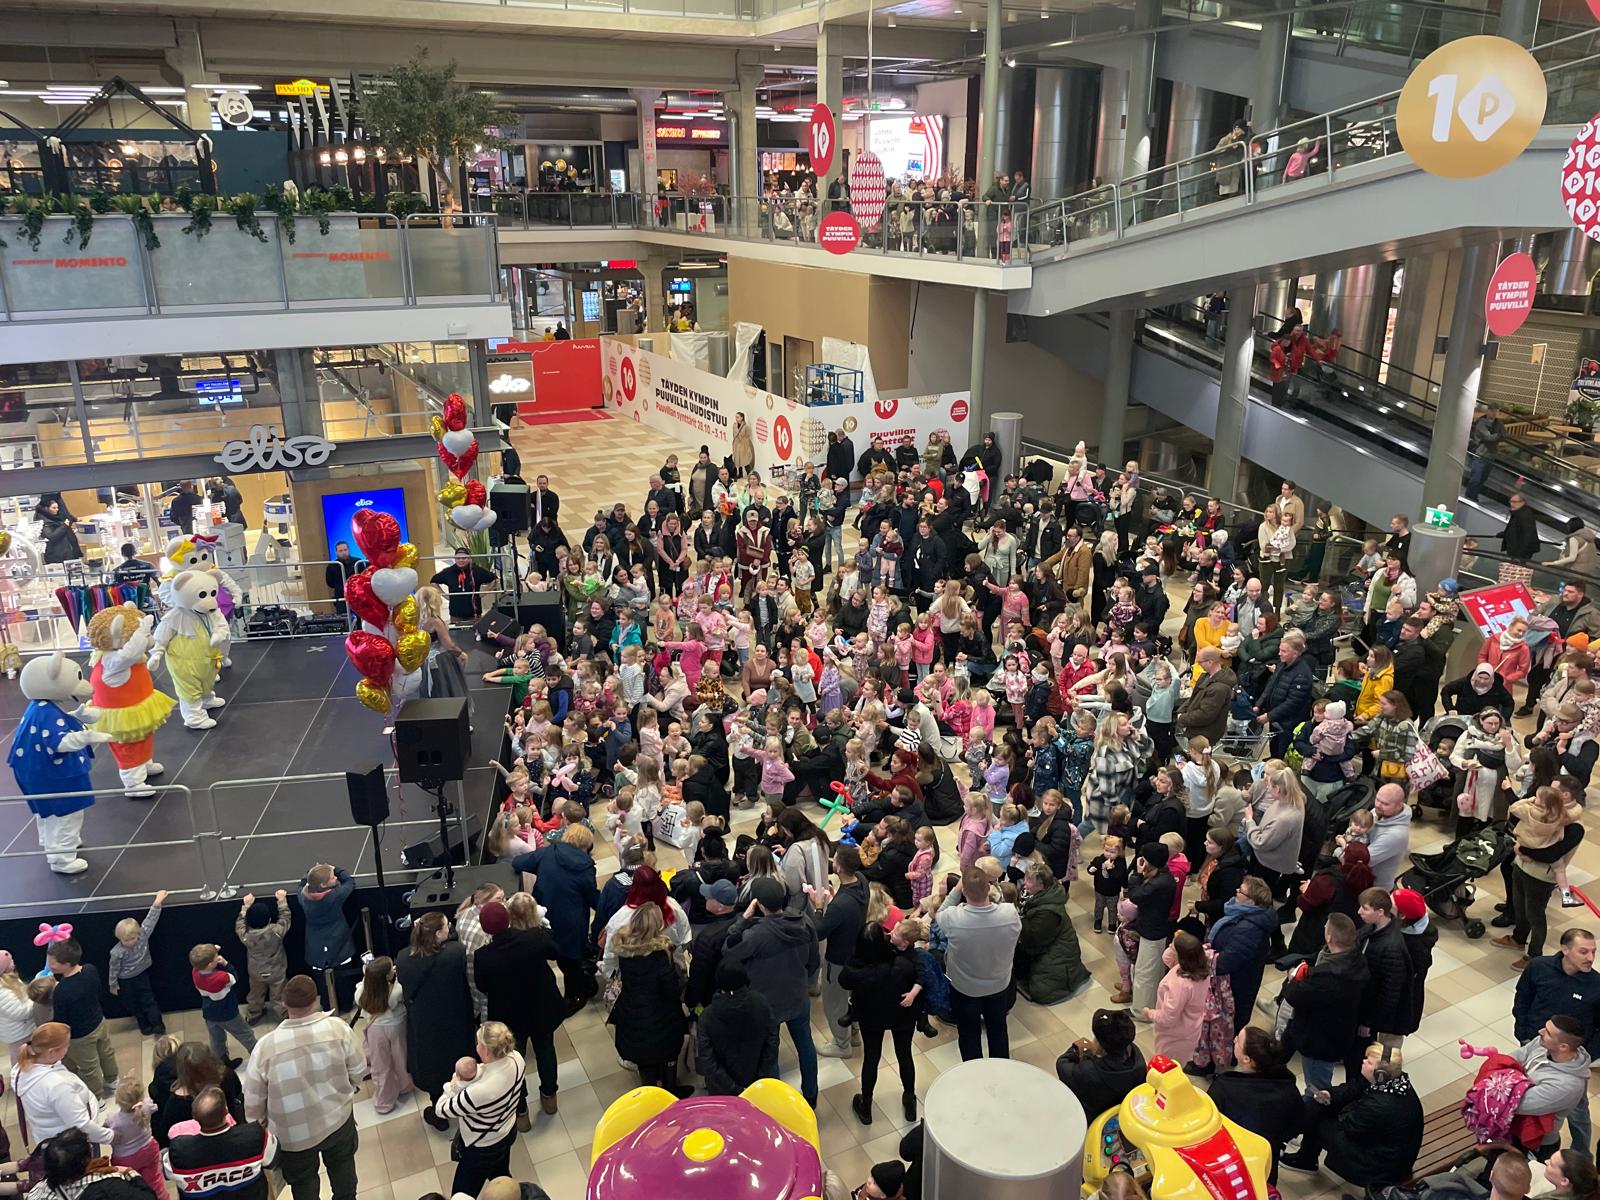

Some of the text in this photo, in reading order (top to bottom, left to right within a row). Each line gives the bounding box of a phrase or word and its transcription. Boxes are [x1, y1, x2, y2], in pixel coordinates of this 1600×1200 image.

[55, 256, 128, 268] MOMENTO
[1497, 281, 1530, 290] TÄYDEN
[1495, 291, 1529, 300] KYMPIN
[1490, 300, 1529, 311] PUUVILLA
[689, 389, 719, 411] KYMPIN
[655, 387, 728, 427] PUUVILLA UUDISTUU
[870, 428, 916, 439] Puuvillan
[213, 424, 337, 473] elisa
